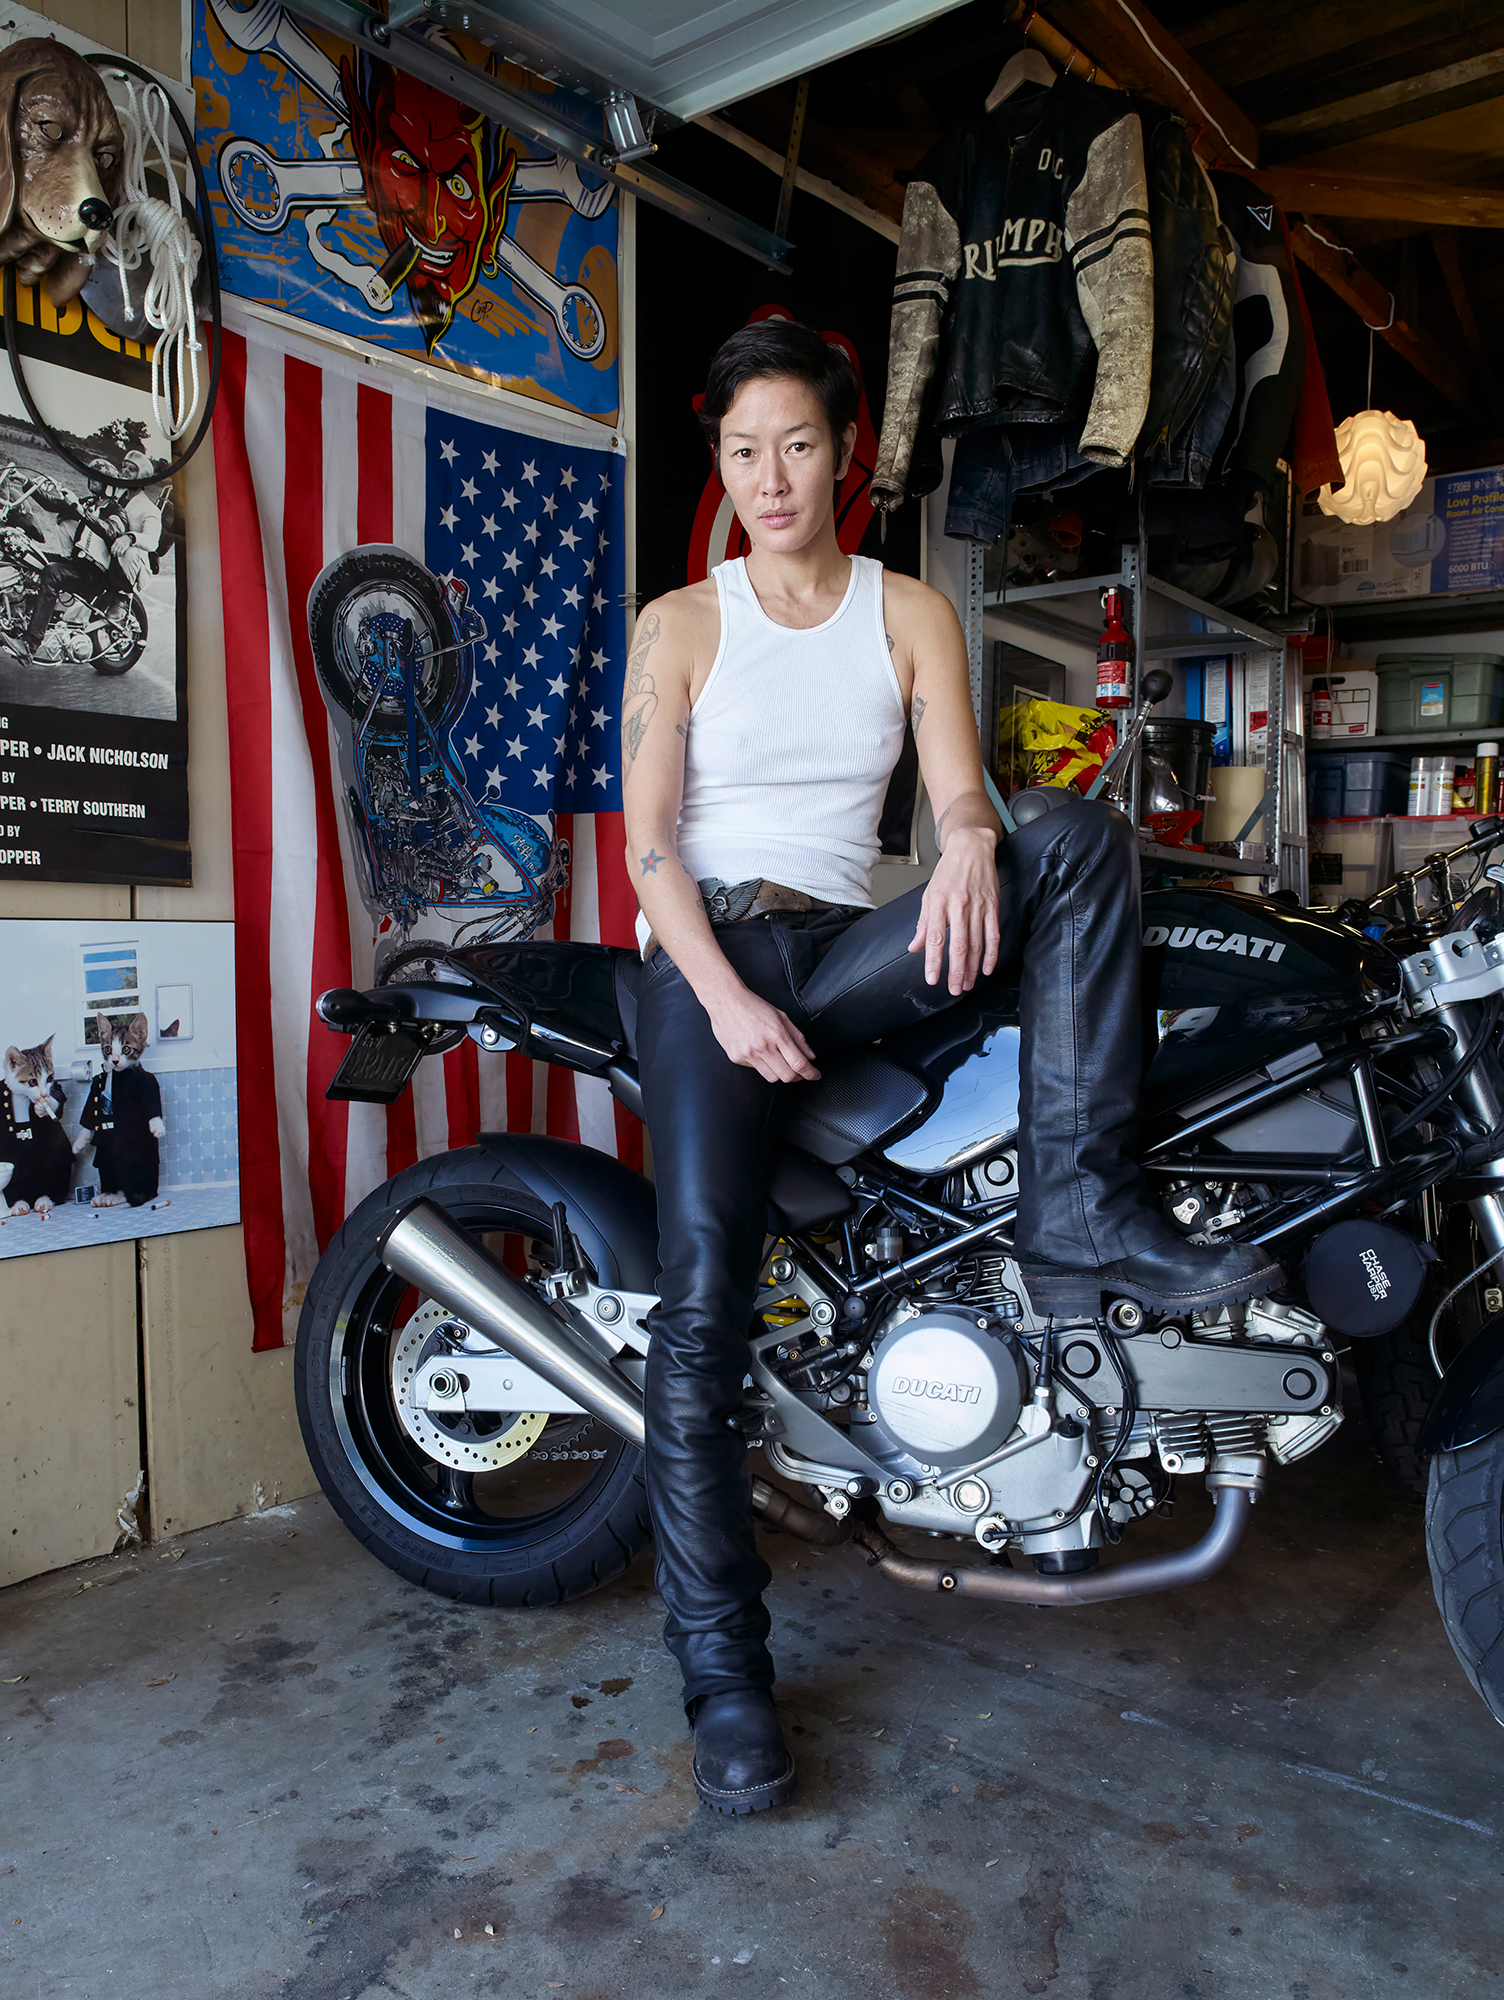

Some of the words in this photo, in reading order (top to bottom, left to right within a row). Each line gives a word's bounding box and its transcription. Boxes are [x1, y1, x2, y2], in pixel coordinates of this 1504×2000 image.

[1038, 148, 1064, 180] DC
[1446, 509, 1470, 519] Room
[1471, 506, 1484, 515] Air
[1447, 498, 1470, 509] Low
[1448, 563, 1469, 574] 6000
[1471, 561, 1489, 572] BTU
[46, 743, 86, 763] JACK
[89, 746, 169, 770] NICHOLSON
[1, 771, 16, 784] BY
[40, 797, 80, 814] TERRY
[82, 800, 146, 819] SOUTHERN
[7, 825, 21, 838] BY
[1142, 926, 1287, 963] DUCATI
[1359, 1251, 1388, 1299] HARPER
[1366, 1249, 1391, 1289] CHASE
[1366, 1281, 1380, 1301] USA
[892, 1377, 981, 1404] DUCATI
[357, 1503, 455, 1569] PIRELLI
